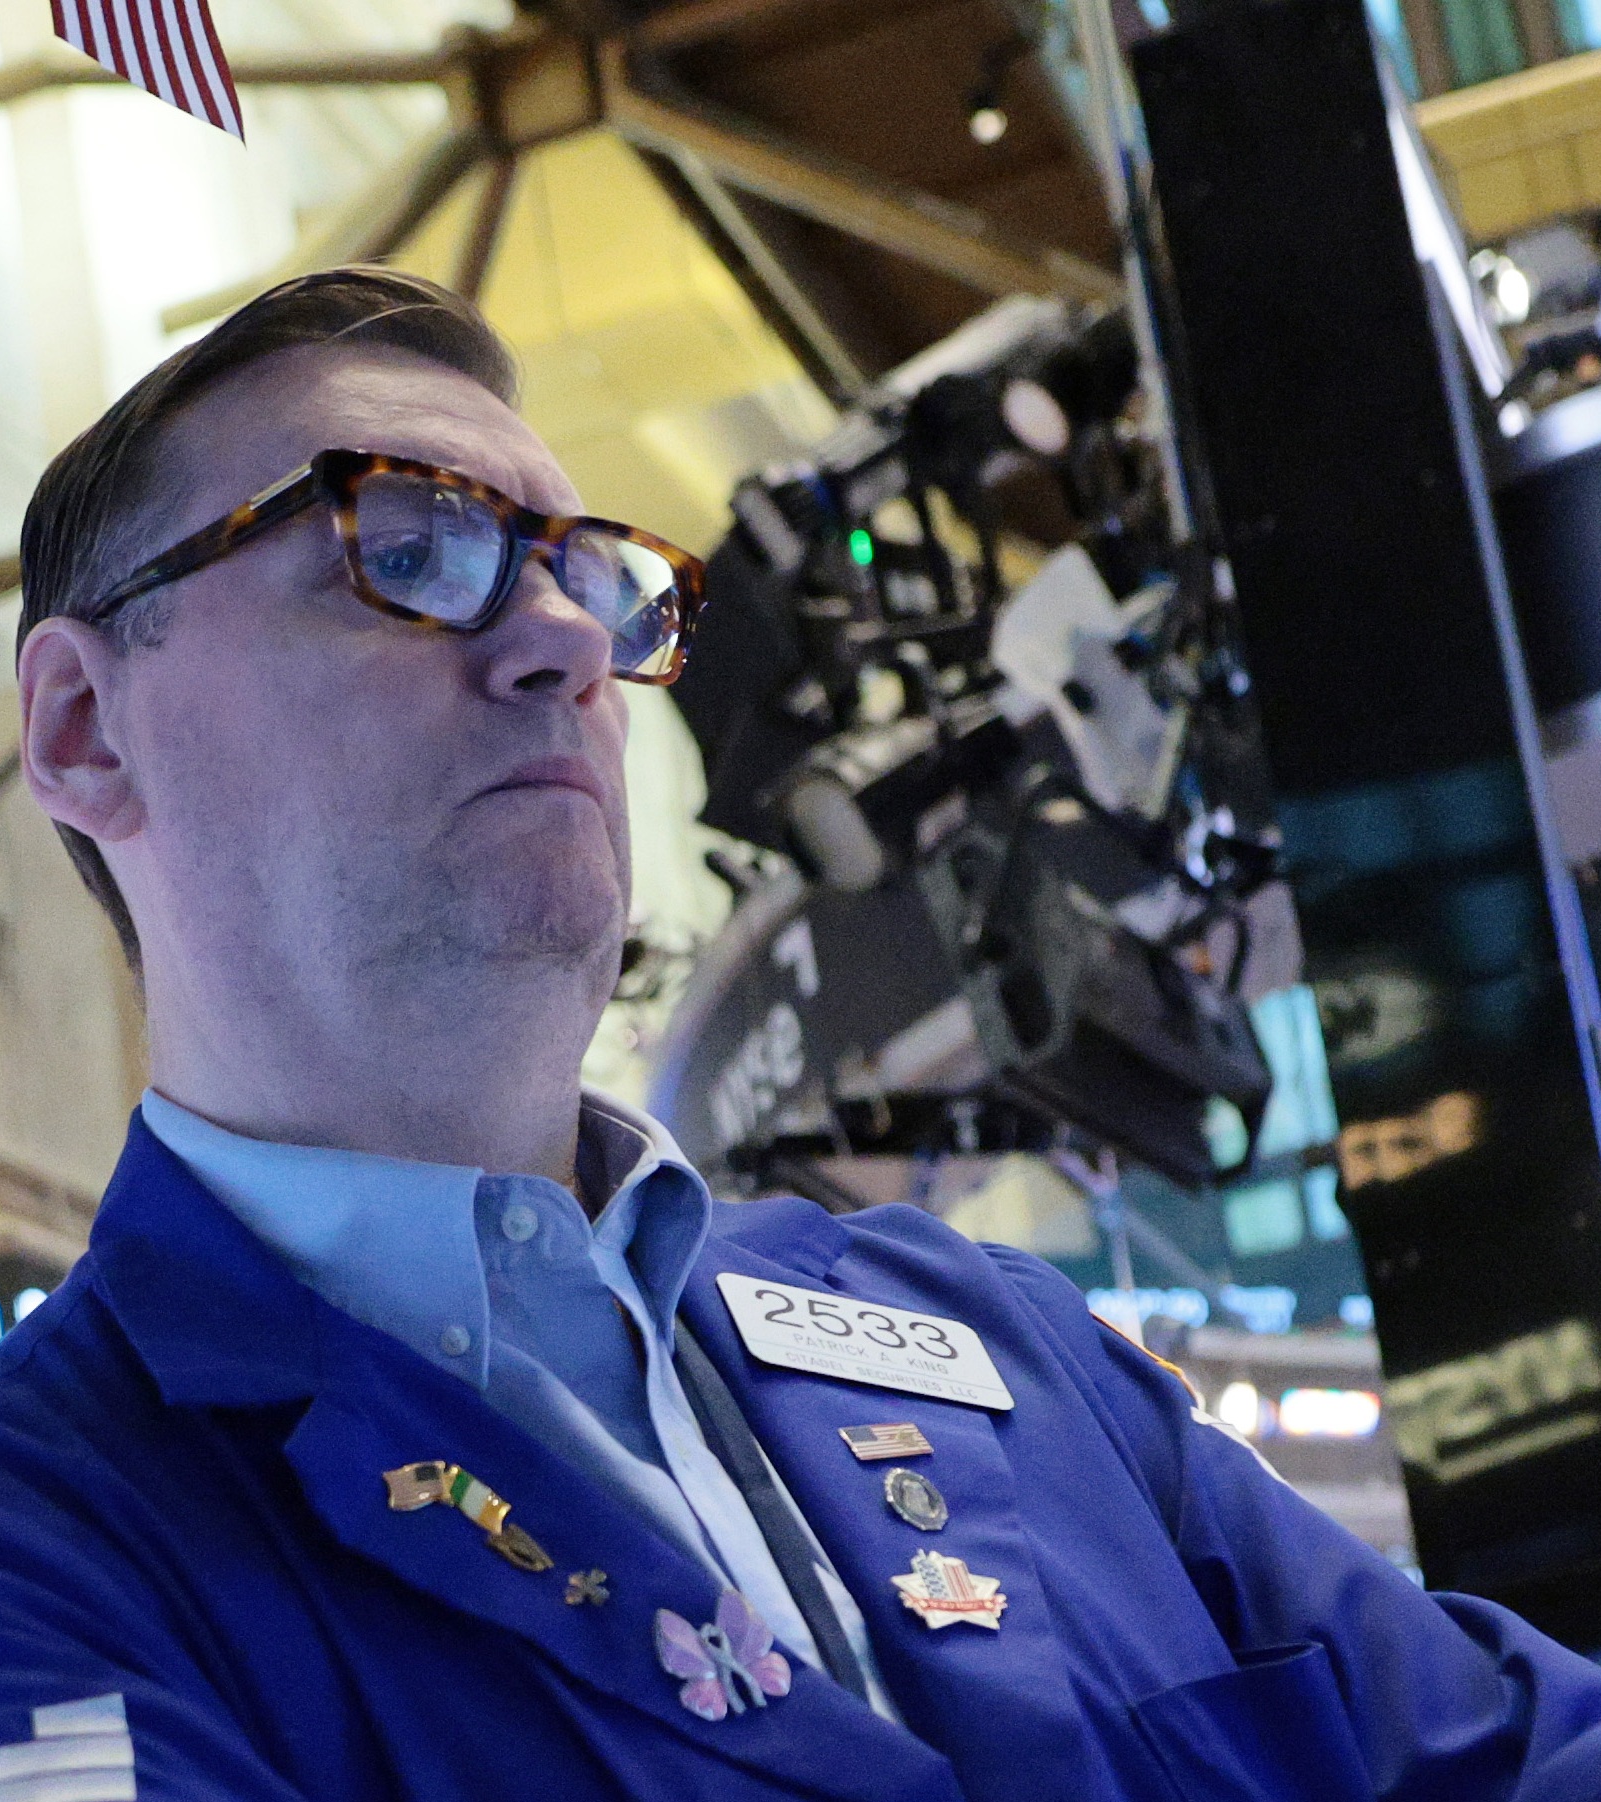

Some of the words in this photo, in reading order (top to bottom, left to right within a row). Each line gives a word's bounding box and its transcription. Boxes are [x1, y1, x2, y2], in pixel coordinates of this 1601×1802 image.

[754, 1288, 959, 1360] 2533
[785, 1352, 850, 1373] CITADEL
[856, 1366, 943, 1392] SECURITIES
[949, 1385, 978, 1399] LLC
[793, 1333, 869, 1358] PATRICK
[906, 1357, 949, 1375] KING
